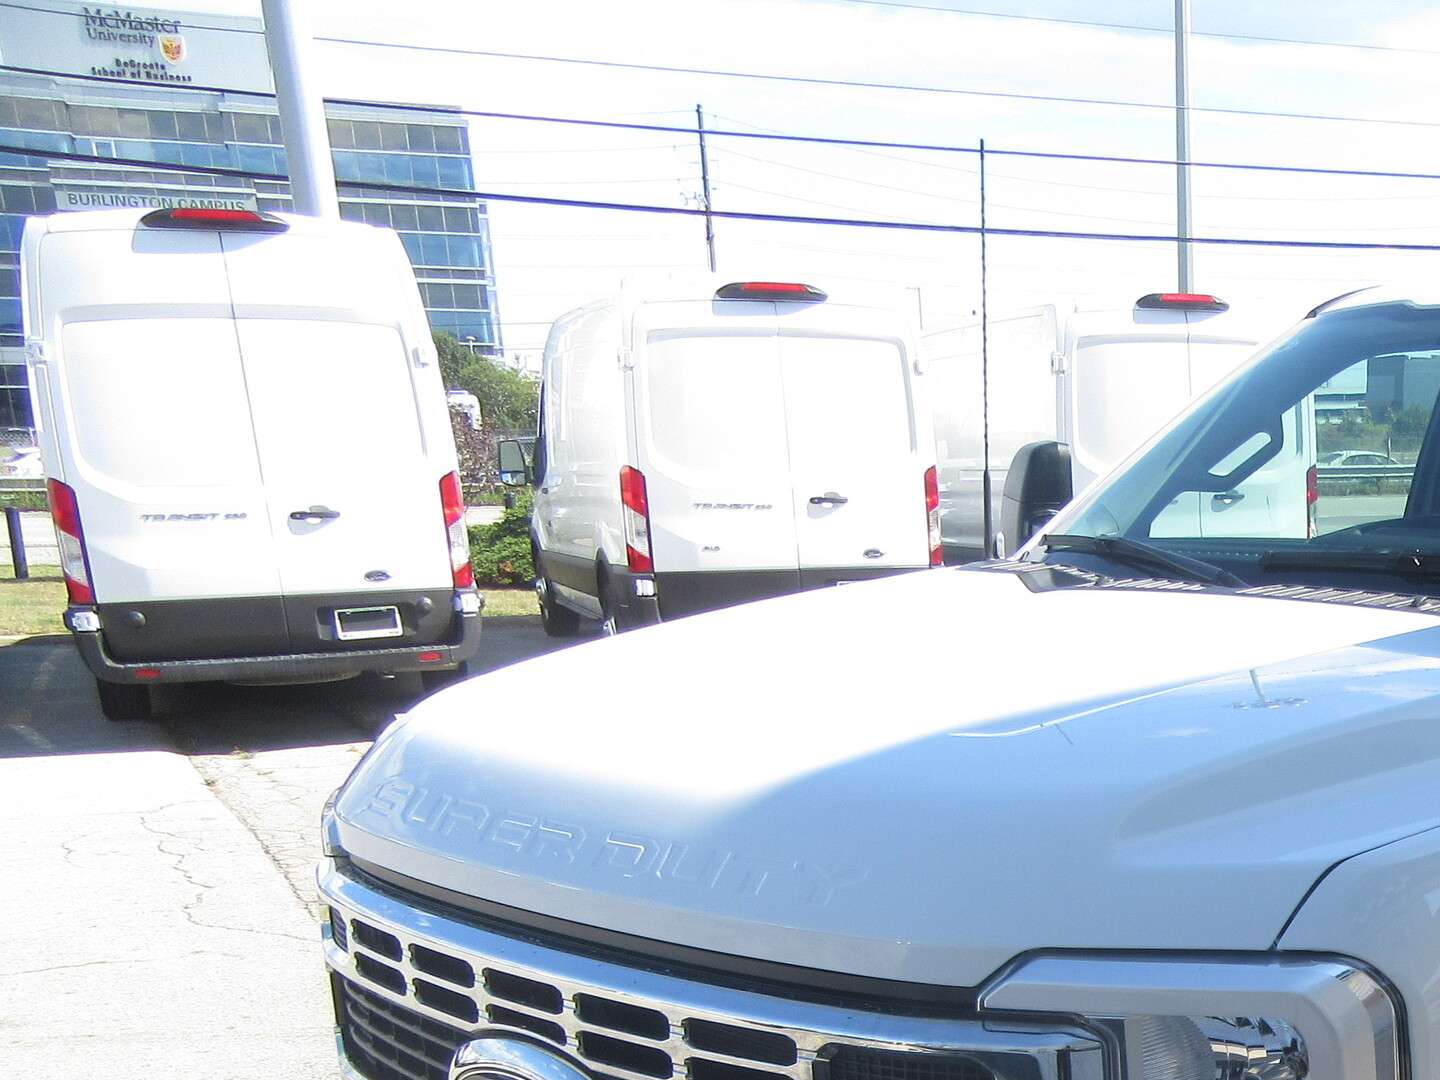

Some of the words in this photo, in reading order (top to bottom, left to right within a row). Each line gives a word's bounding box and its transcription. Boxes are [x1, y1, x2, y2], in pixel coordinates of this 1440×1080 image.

[82, 7, 181, 33] McMaster
[86, 28, 155, 48] University
[91, 67, 127, 78] School
[130, 70, 141, 78] of
[145, 71, 192, 82] Business
[68, 193, 173, 208] BURLINGTON
[178, 198, 245, 210] CAMPUS
[373, 780, 587, 864] SUPER
[597, 831, 871, 907] DUTY
